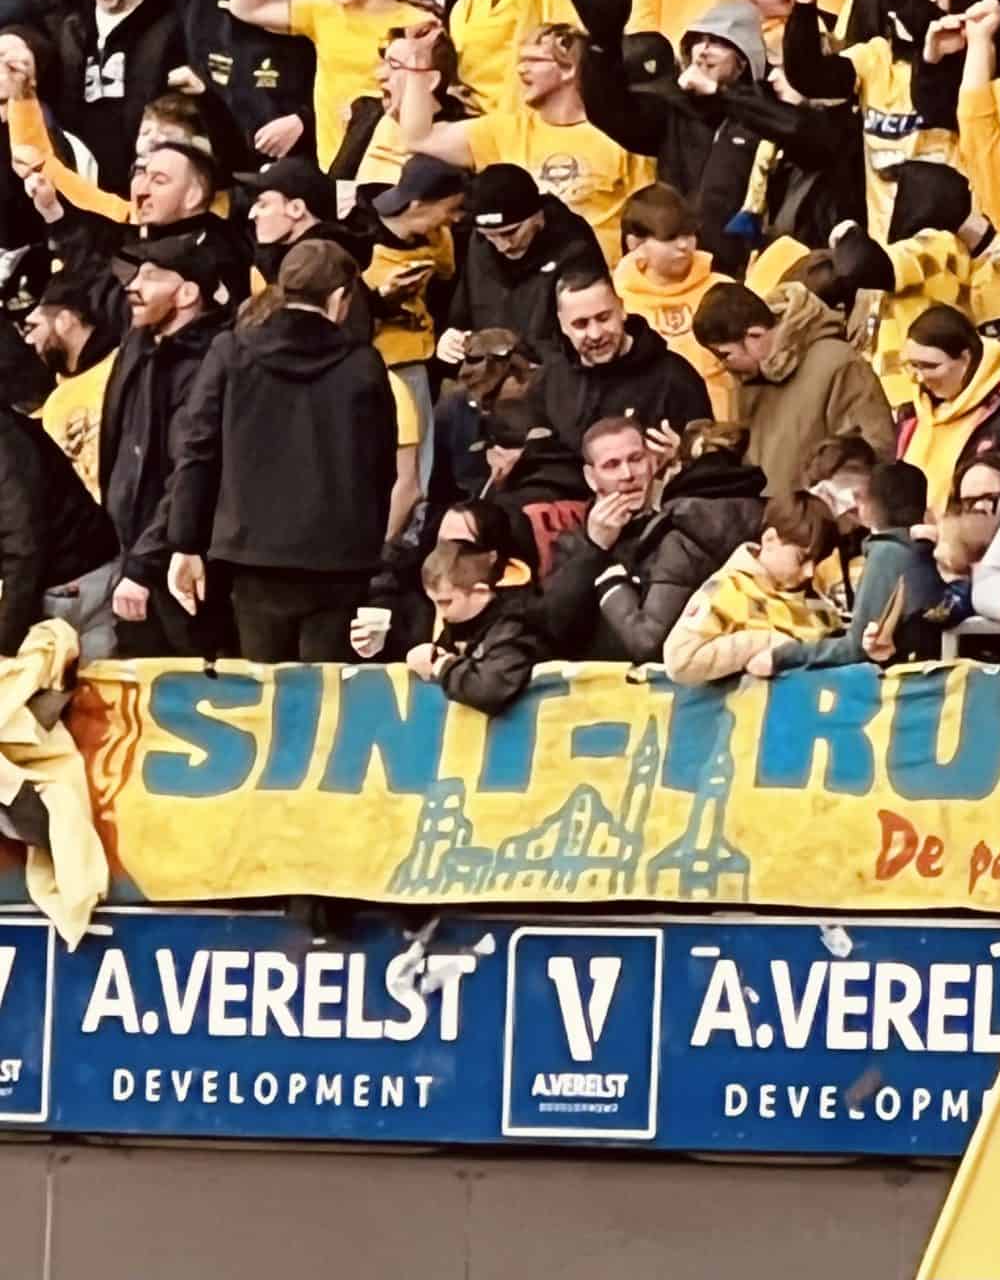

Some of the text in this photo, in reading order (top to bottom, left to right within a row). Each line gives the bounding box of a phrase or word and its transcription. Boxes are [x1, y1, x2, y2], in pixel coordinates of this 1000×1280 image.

[875, 809, 944, 881] De
[81, 948, 477, 1041] A.VERELST
[112, 1068, 434, 1108] DEVELOPMENT
[725, 1083, 996, 1122] DEVEOPM
